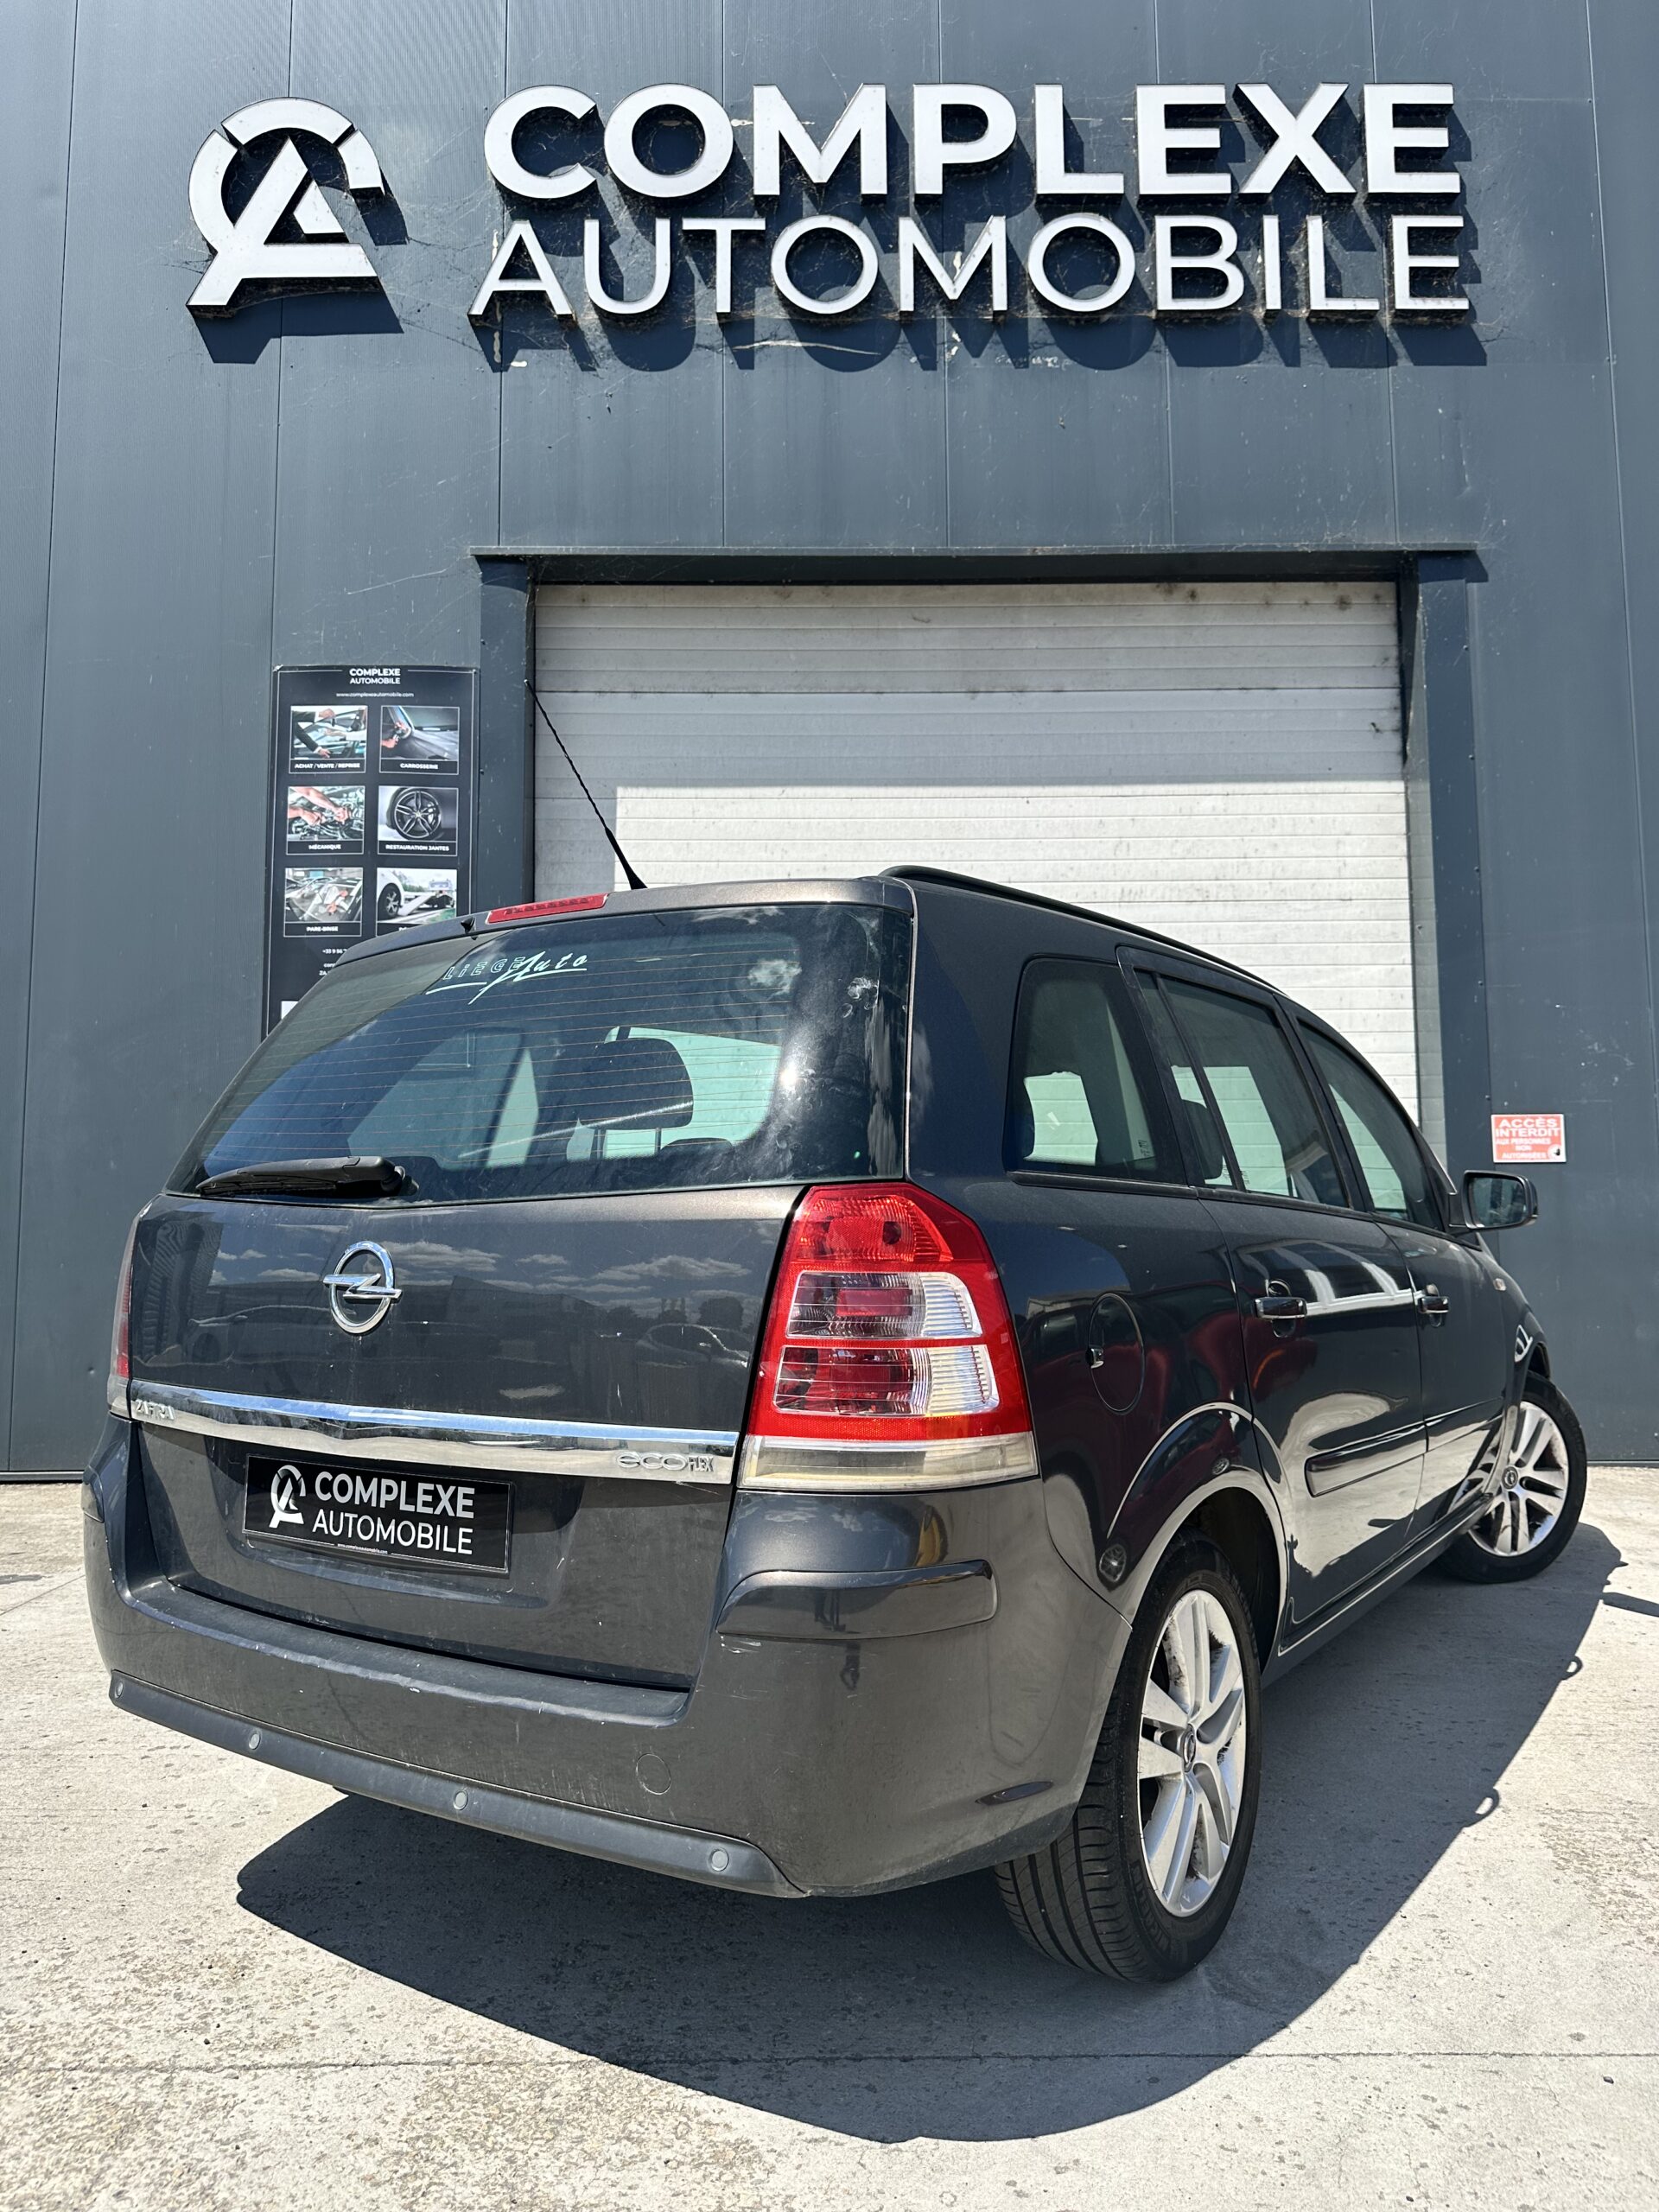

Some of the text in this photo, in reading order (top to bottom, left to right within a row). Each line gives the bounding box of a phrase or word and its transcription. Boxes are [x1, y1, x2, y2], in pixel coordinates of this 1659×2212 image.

[484, 83, 1461, 200] COMPLEXE
[468, 214, 1470, 315] AUTOMOBILE
[349, 668, 401, 677] COMPLEXE
[1496, 1128, 1560, 1138] INTERDIT
[315, 1471, 475, 1519] COMPLEXE
[312, 1509, 474, 1555] AUTOMOBILE
